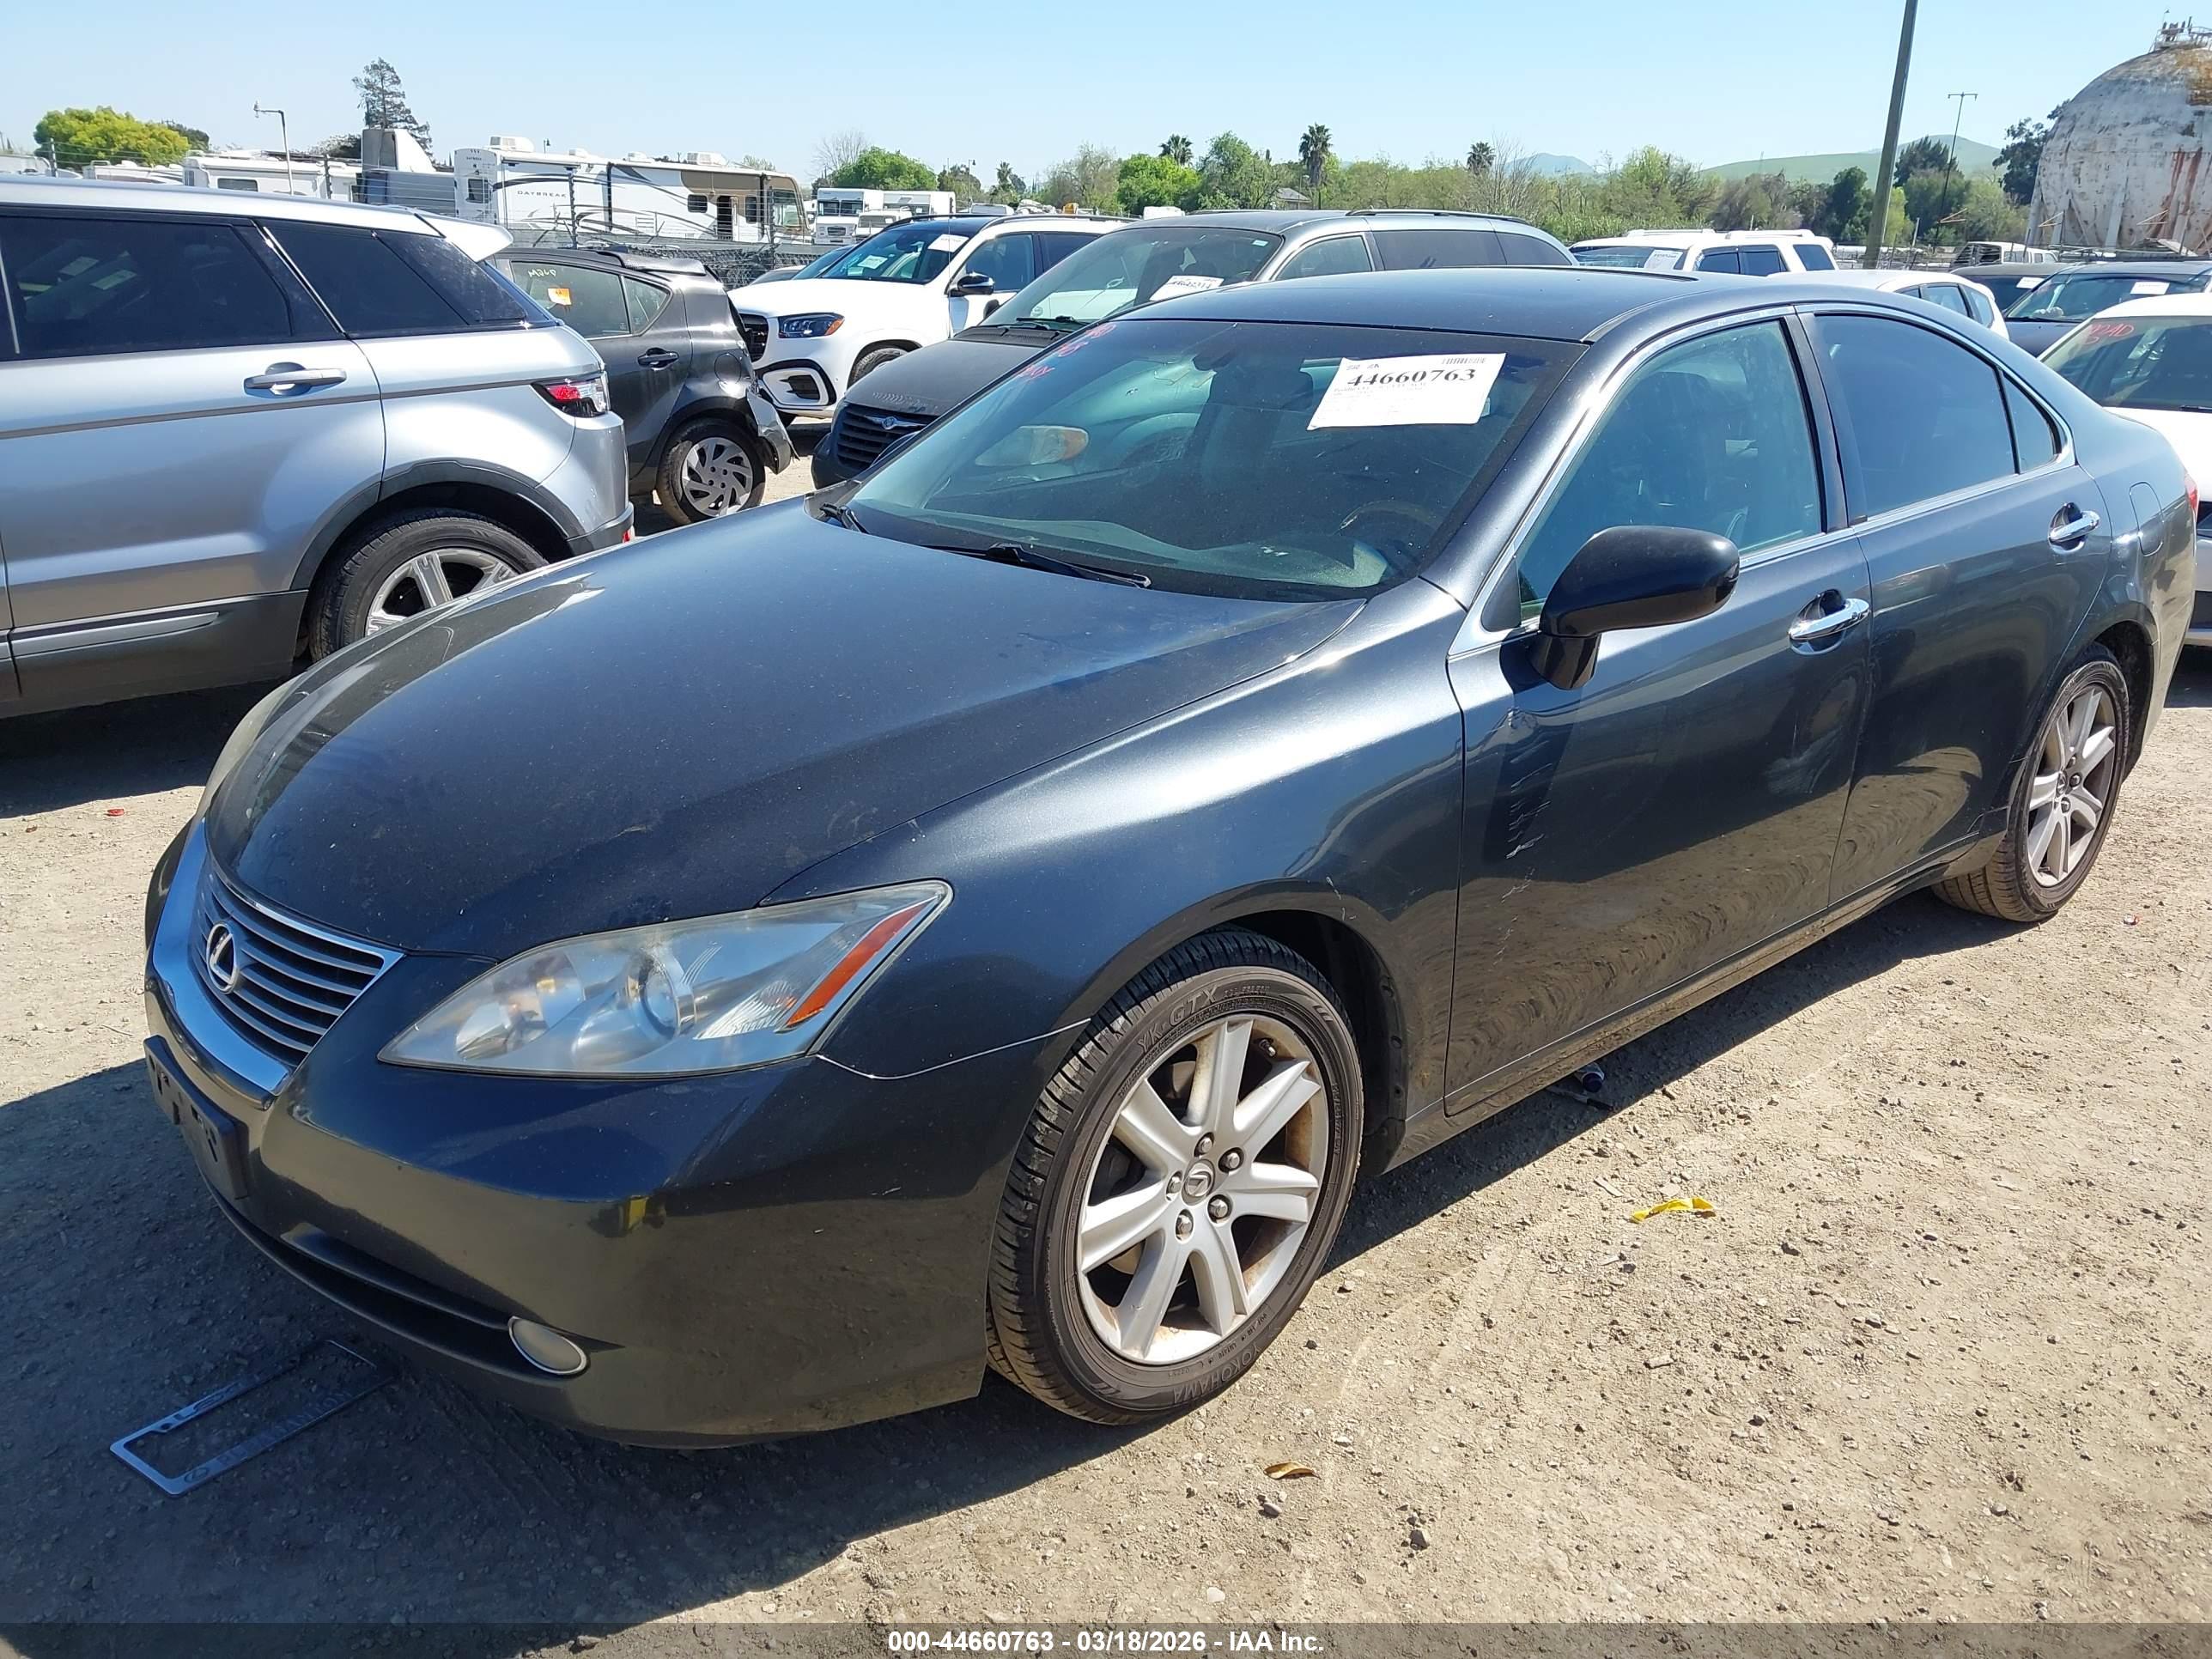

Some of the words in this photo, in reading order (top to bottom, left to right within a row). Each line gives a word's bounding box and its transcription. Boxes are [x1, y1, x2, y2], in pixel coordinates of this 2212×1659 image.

[517, 190, 567, 198] DAYBREAK
[1347, 368, 1476, 386] 44660763
[1172, 1343, 1261, 1404] YOKOHAMA
